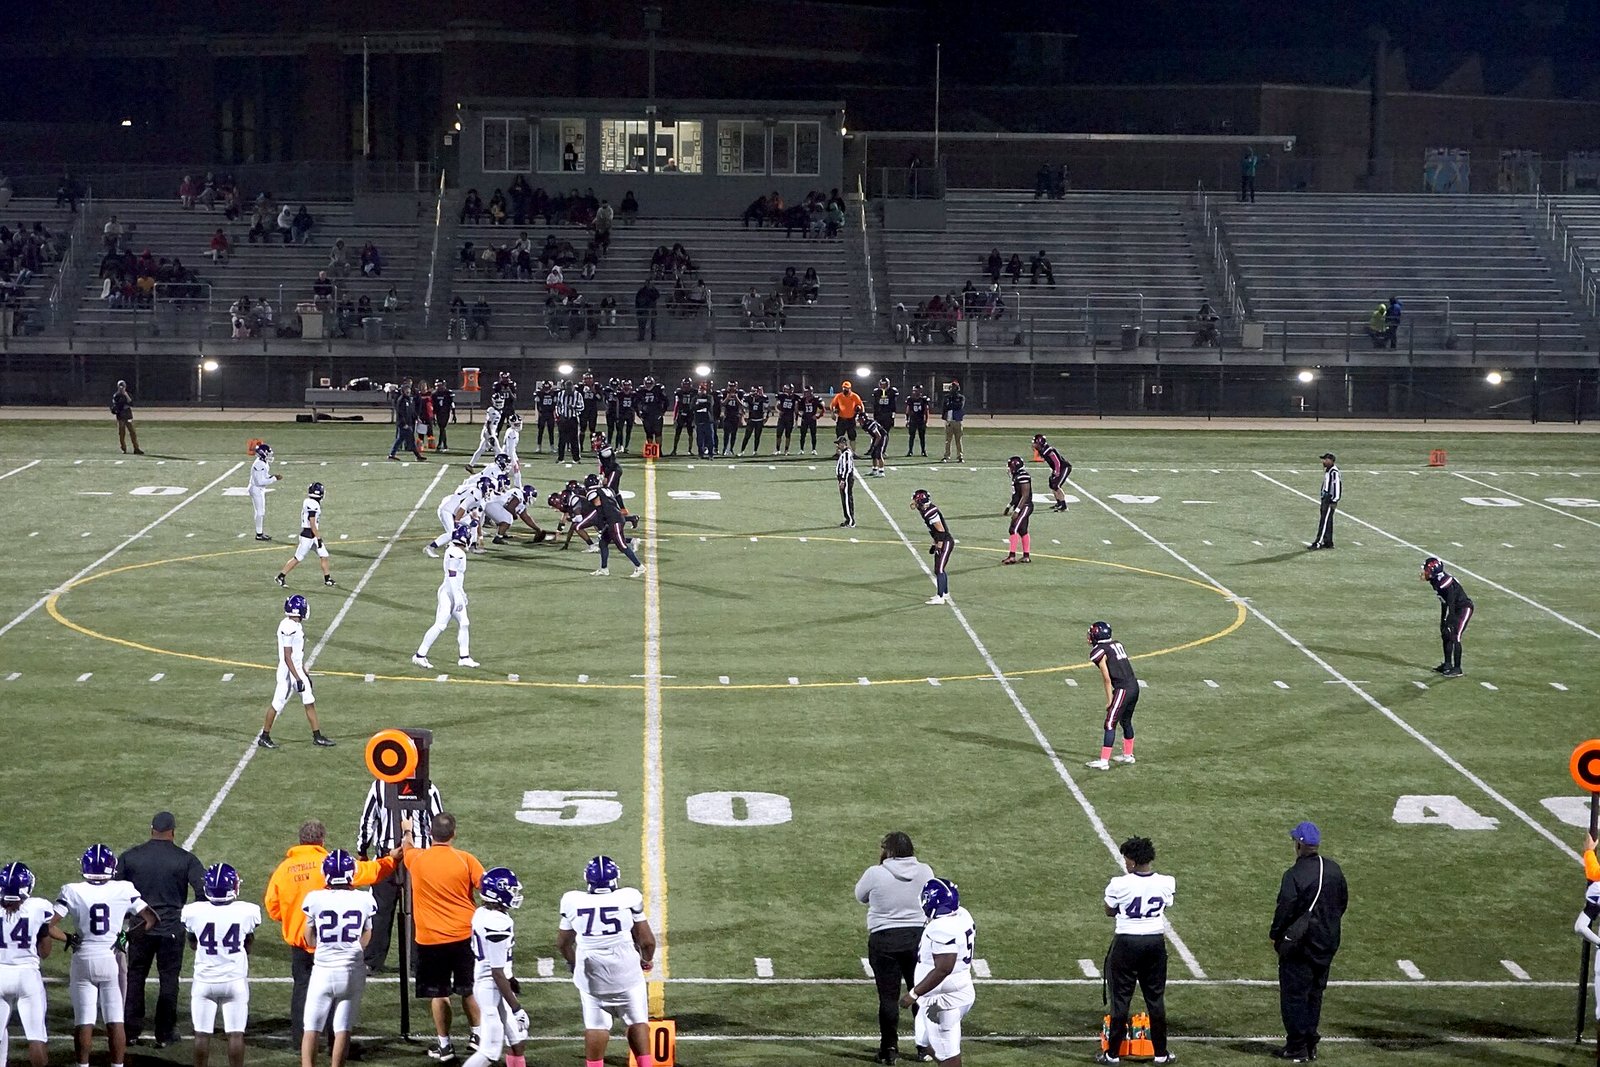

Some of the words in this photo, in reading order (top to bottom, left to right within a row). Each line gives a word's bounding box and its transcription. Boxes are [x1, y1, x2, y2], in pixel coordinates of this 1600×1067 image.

[645, 444, 658, 457] 50
[1432, 453, 1446, 464] 30
[1110, 642, 1128, 660] 10
[294, 872, 310, 882] CREW
[90, 903, 110, 935] 8
[577, 906, 622, 936] 75
[1125, 896, 1164, 918] 42
[199, 922, 241, 955] 44
[319, 910, 362, 942] 22
[962, 924, 976, 964] 5
[655, 1027, 669, 1062] 0
